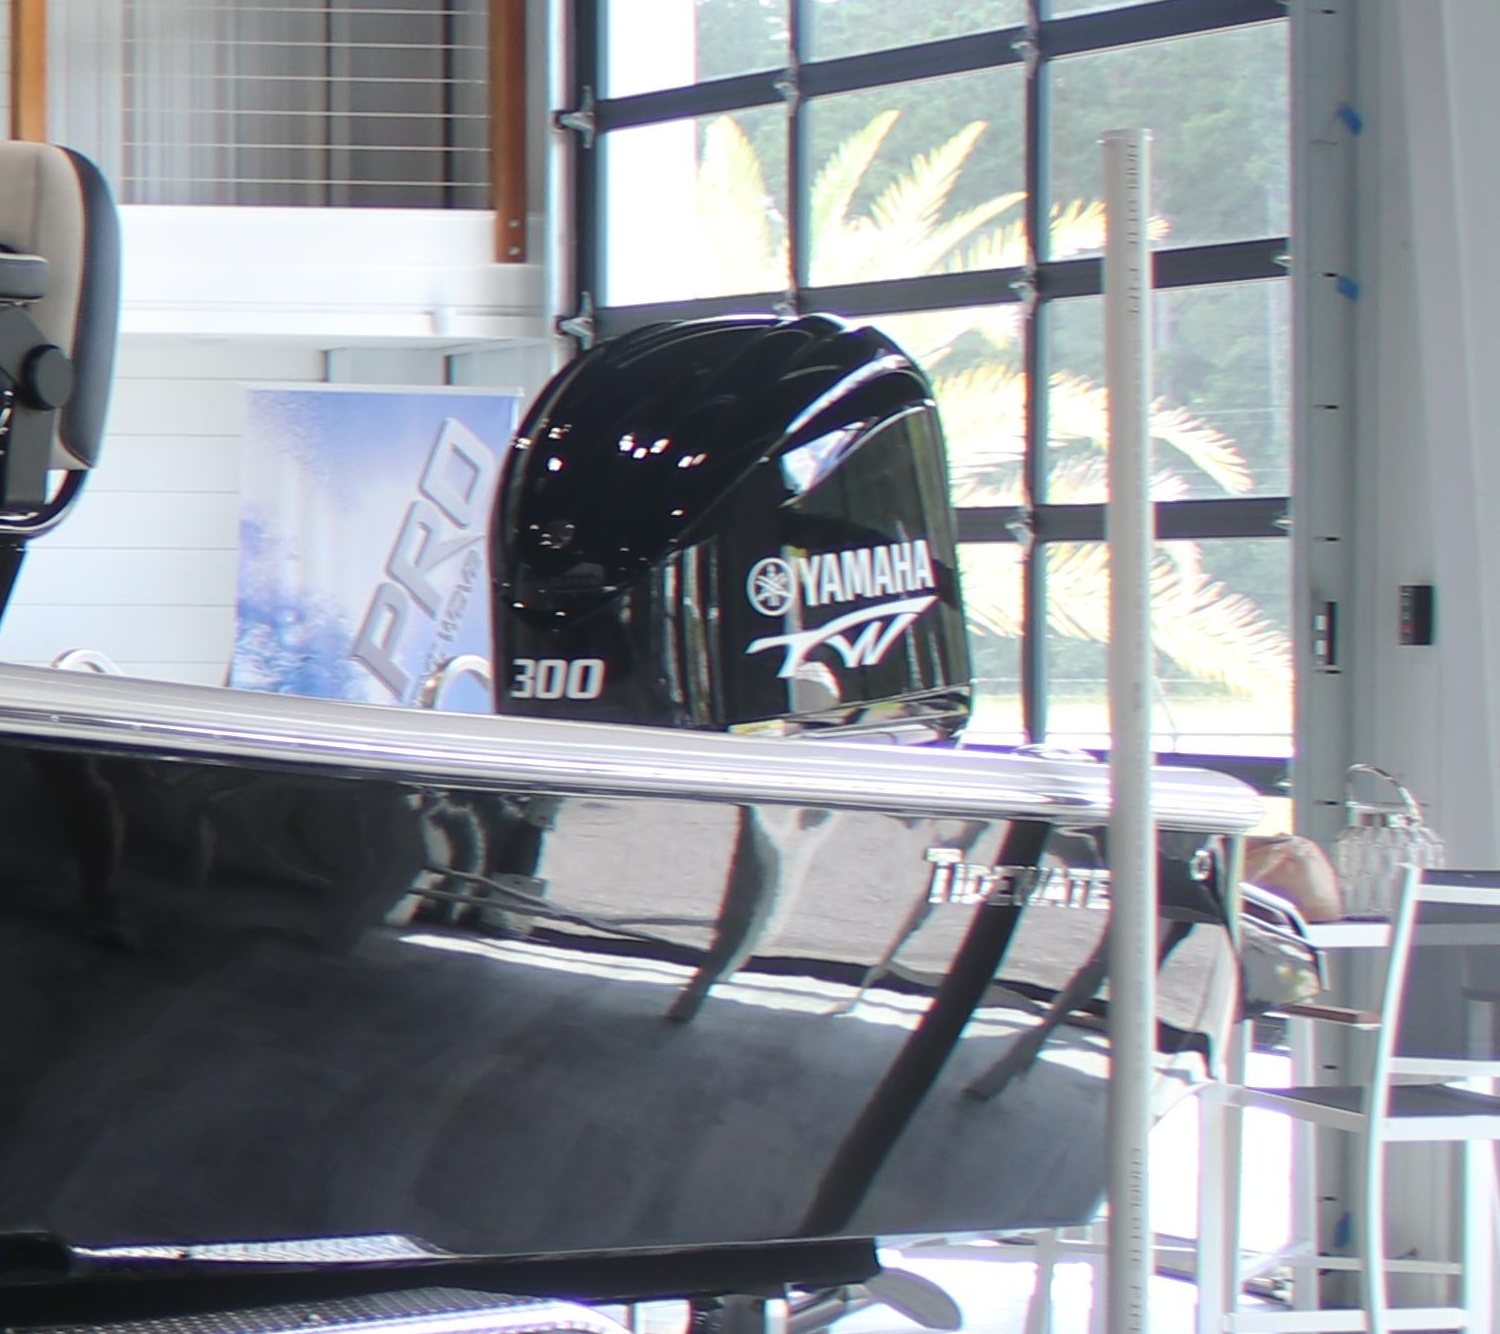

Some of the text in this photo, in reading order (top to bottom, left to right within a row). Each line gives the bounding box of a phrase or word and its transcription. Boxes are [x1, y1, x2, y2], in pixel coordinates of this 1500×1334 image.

[349, 417, 497, 703] PRO
[800, 540, 935, 606] YAMAHA
[510, 658, 605, 699] 300
[925, 847, 1111, 910] TIDEWATE
